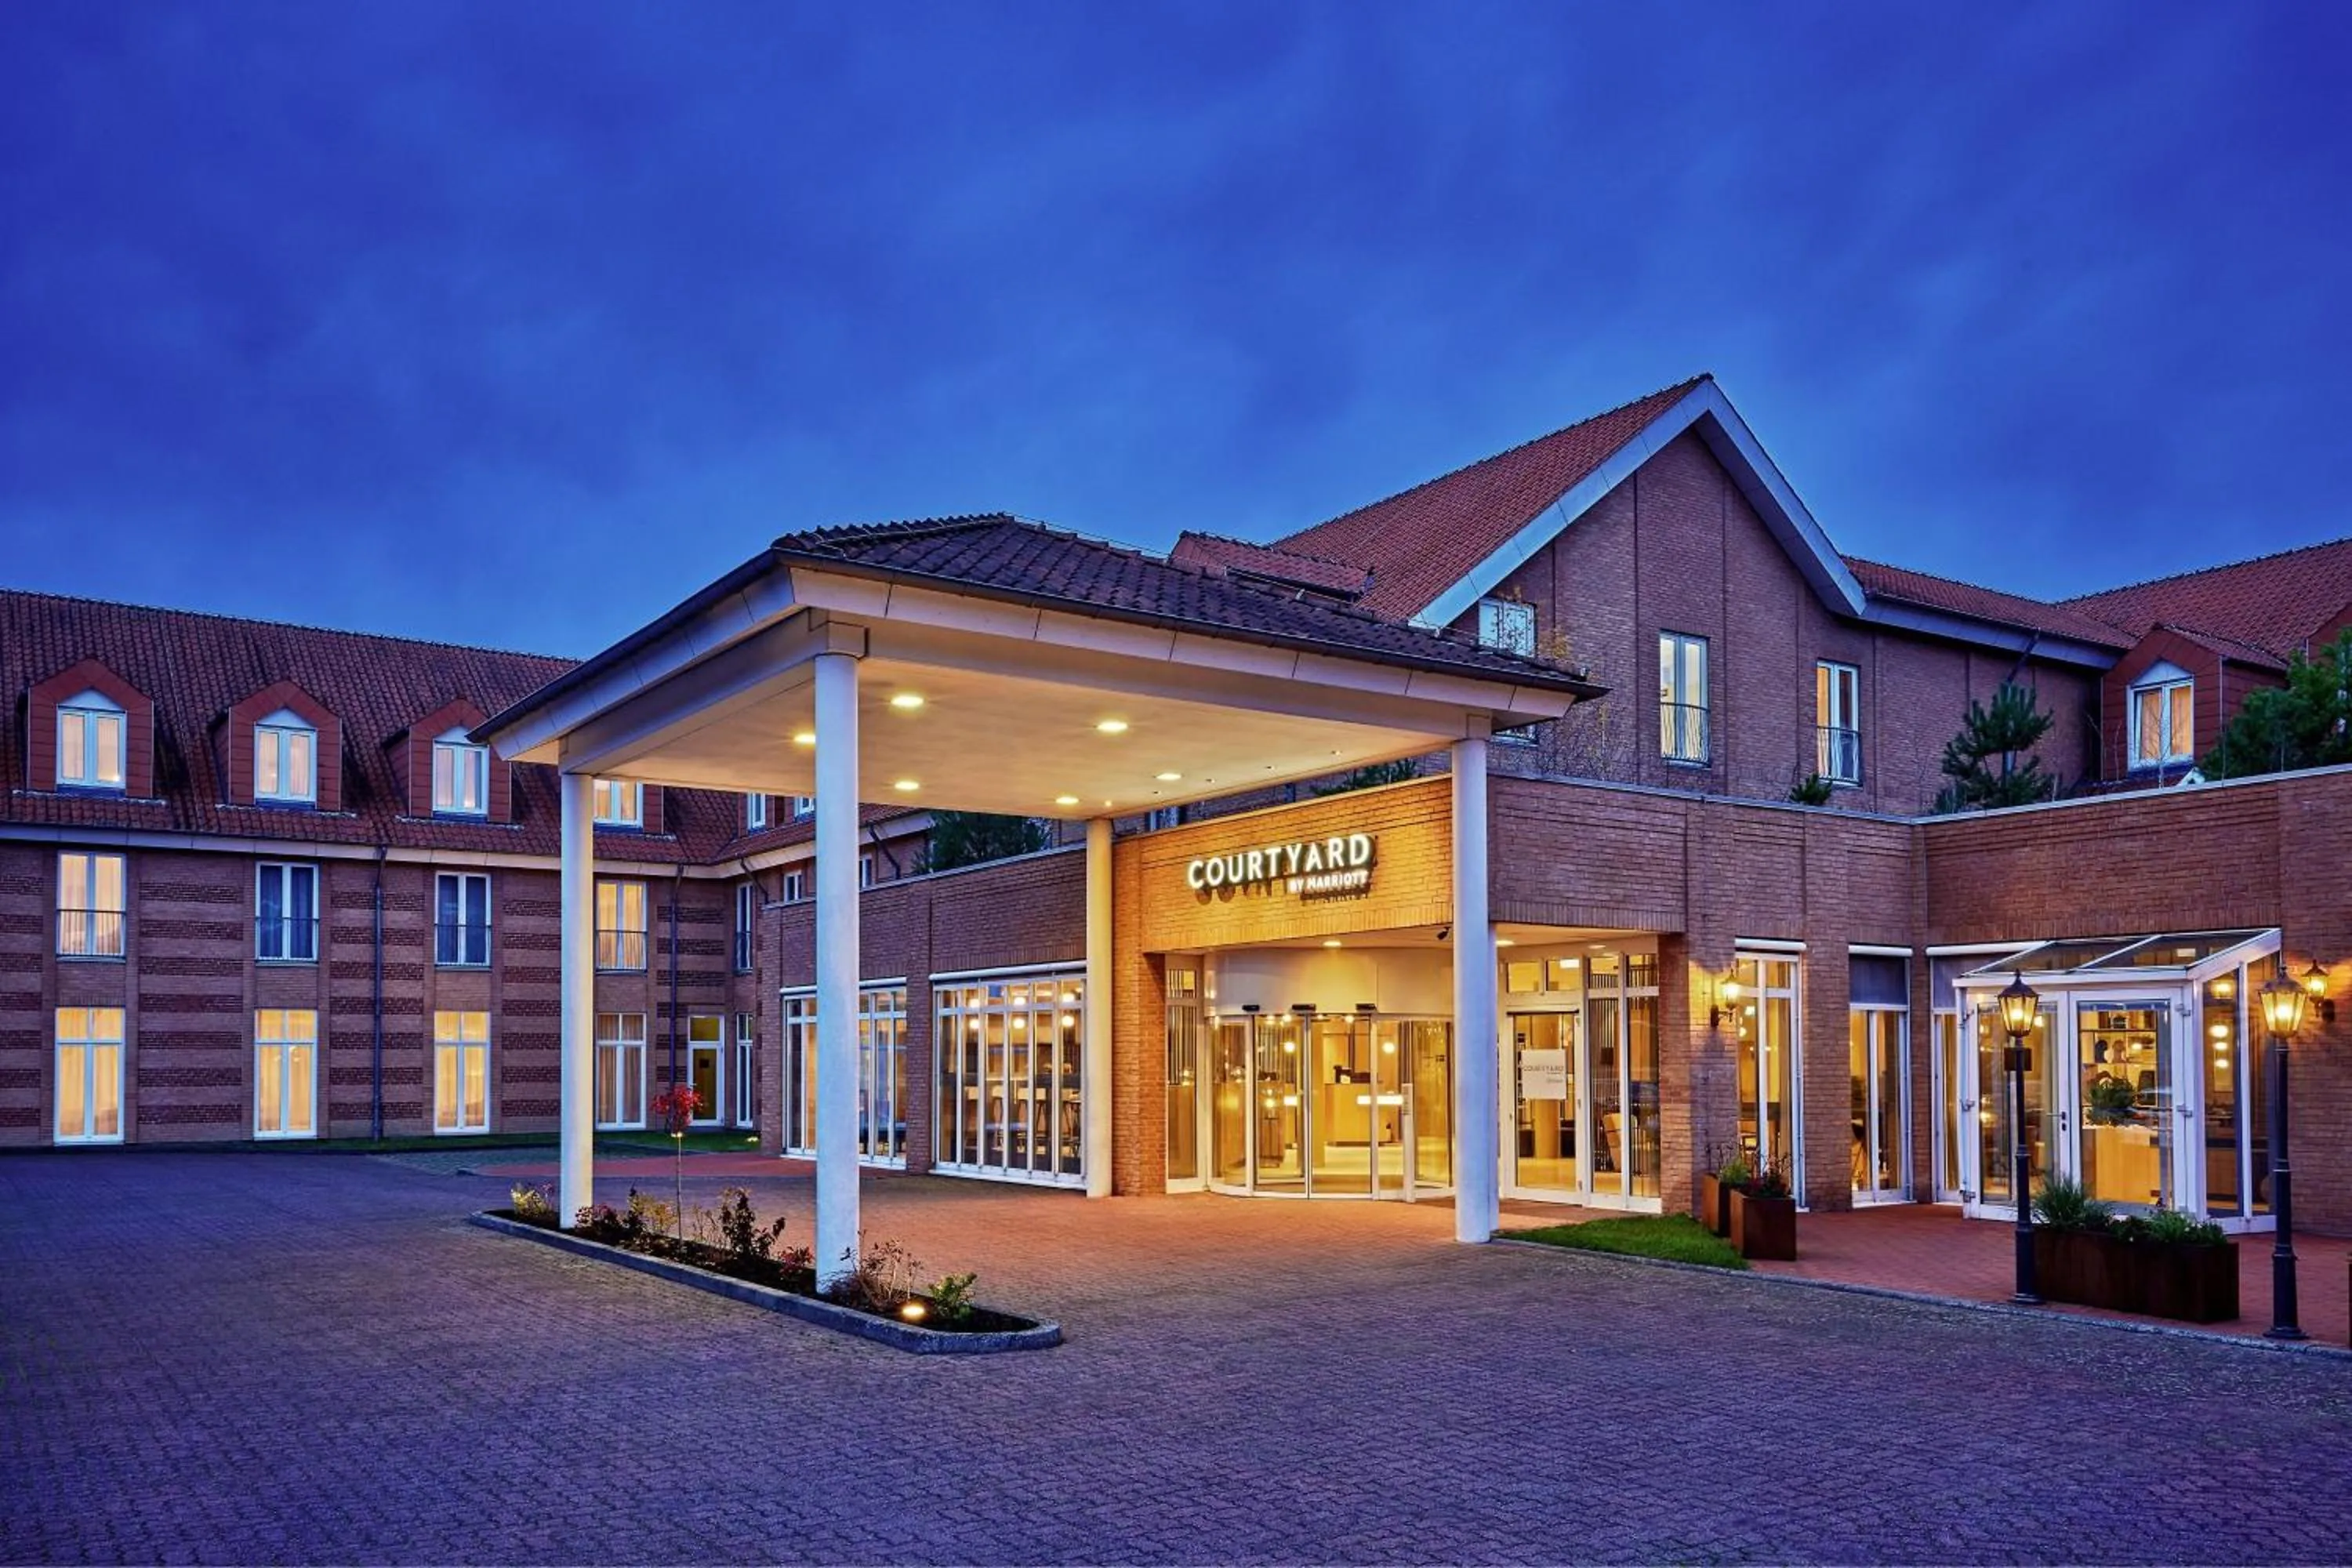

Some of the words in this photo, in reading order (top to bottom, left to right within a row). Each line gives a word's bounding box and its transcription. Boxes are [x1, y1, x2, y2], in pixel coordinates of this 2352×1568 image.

[1187, 833, 1370, 889] COURTYARD
[1290, 878, 1305, 894] BY
[1307, 869, 1369, 891] MARRIOTT
